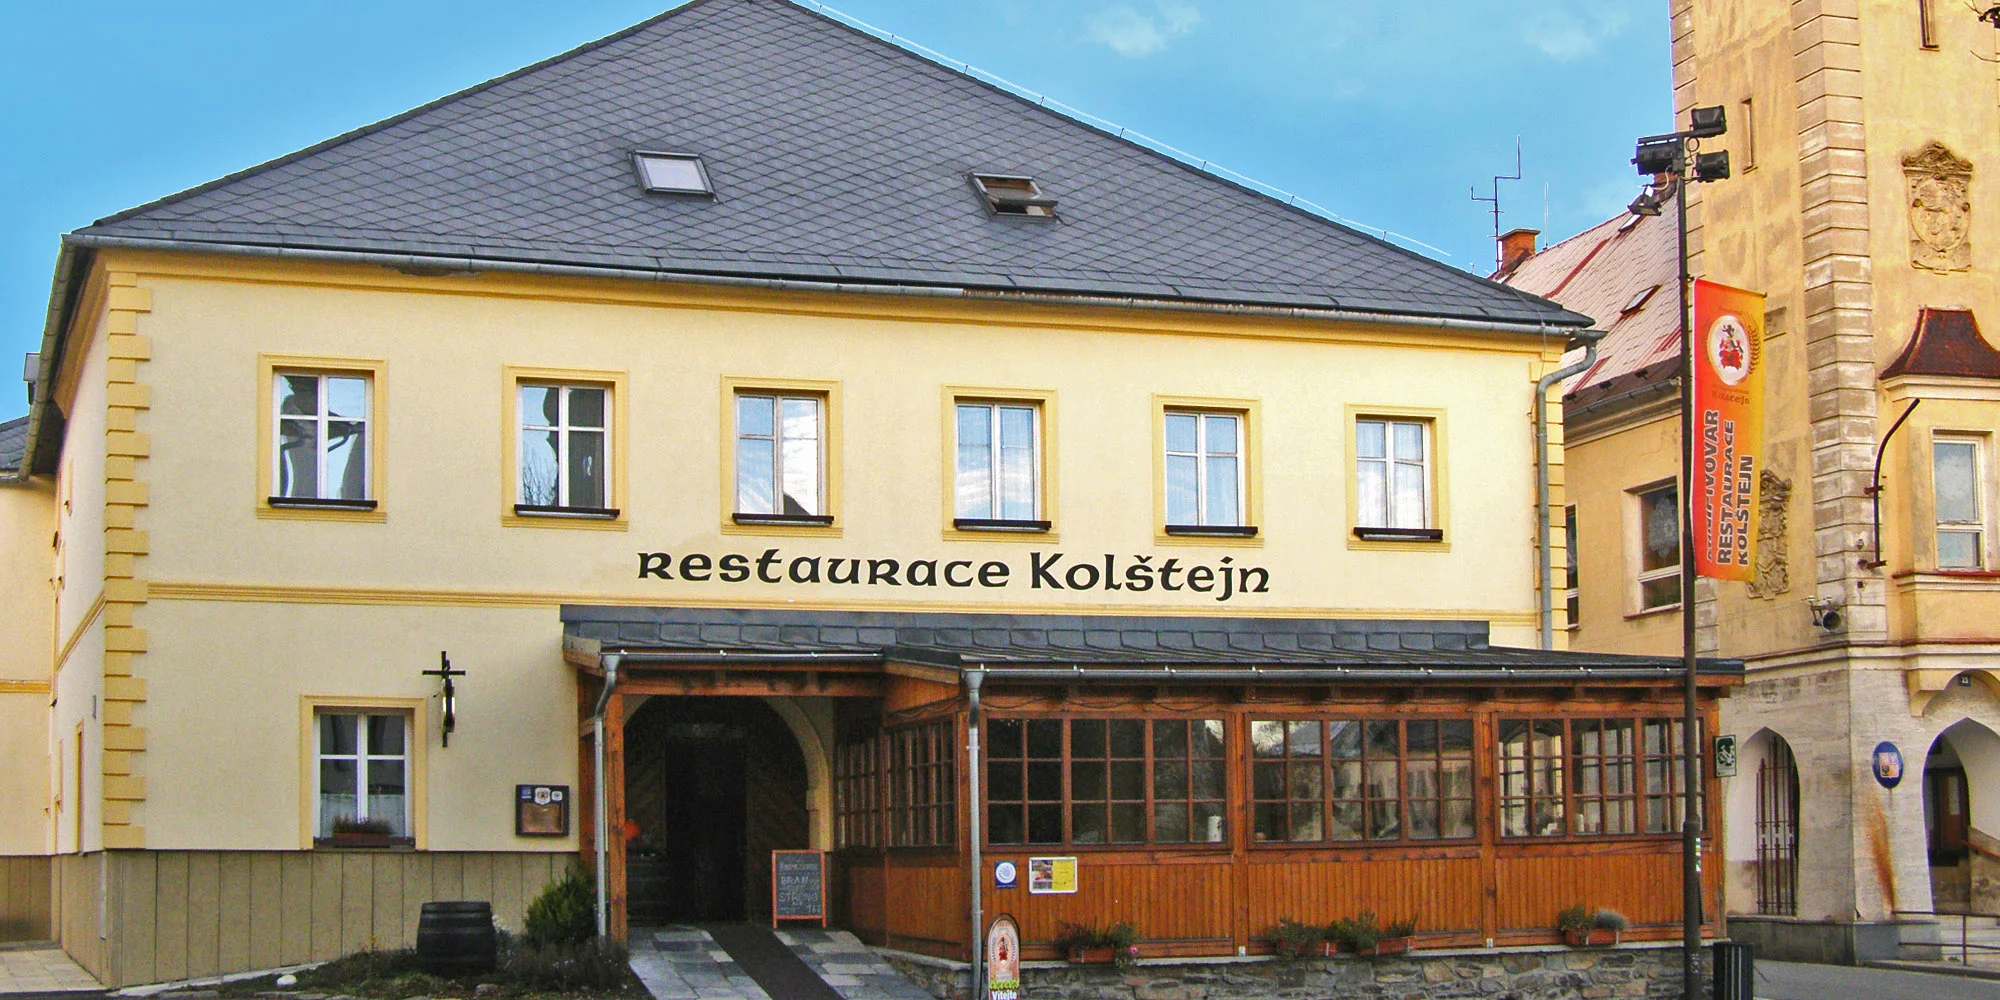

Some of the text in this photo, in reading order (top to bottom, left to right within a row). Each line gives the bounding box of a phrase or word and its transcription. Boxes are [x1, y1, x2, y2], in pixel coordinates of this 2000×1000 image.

[1716, 419, 1735, 565] RESTAURACE
[1735, 455, 1754, 566] KOLŠTEJN
[1030, 552, 1271, 604] Kolštejn
